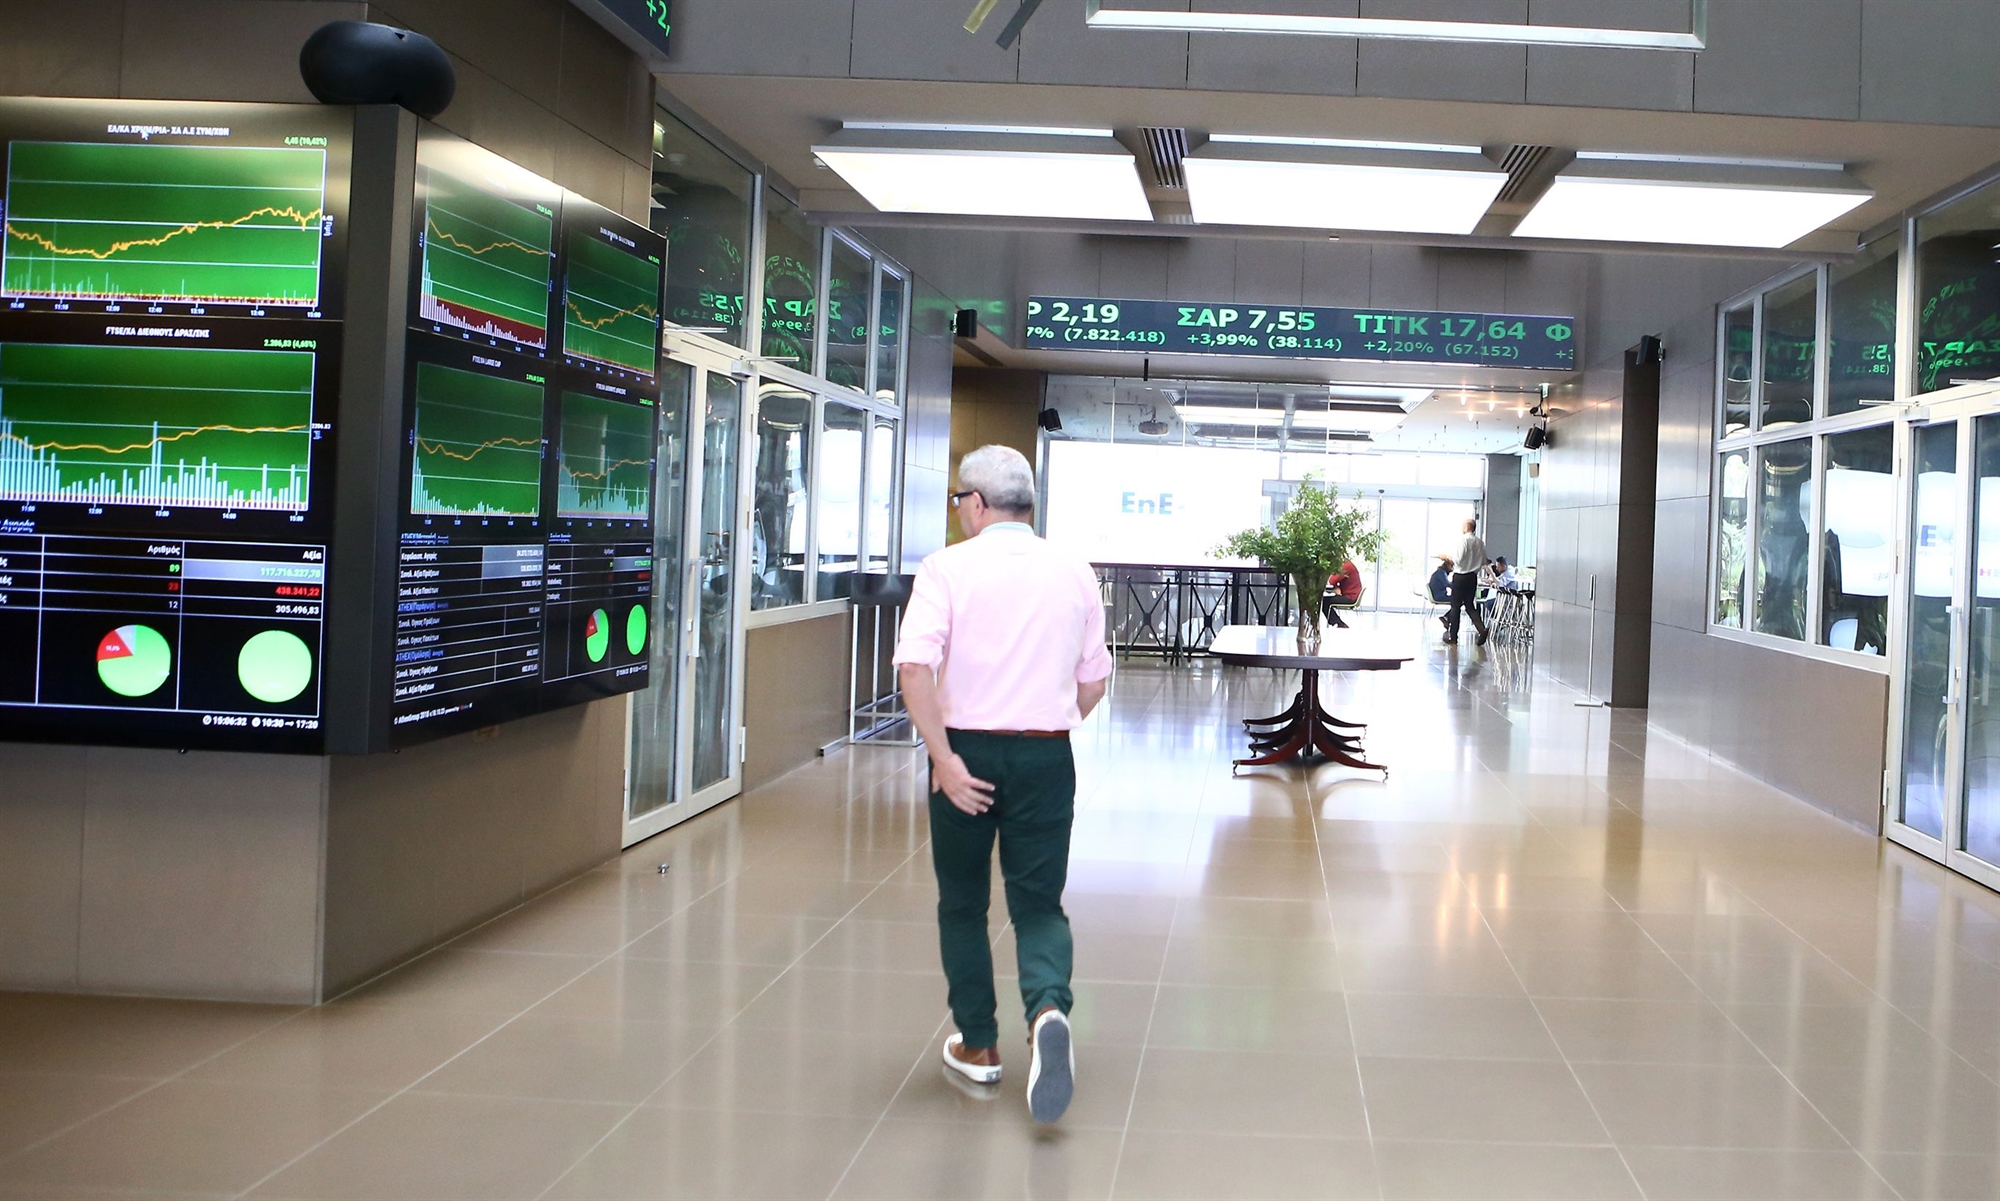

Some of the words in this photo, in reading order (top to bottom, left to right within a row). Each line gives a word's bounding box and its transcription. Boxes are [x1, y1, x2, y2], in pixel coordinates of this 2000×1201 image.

[1051, 302, 1119, 326] 2,19
[1177, 307, 1239, 328] ΣΑΡ
[1248, 309, 1316, 334] 7,55
[1027, 326, 1055, 339] 7%
[1064, 327, 1166, 345] (7.822.418)
[1353, 314, 1429, 336] ΤΙΤΚ
[1440, 318, 1526, 341] 17,64
[1545, 323, 1572, 342] Φ
[1187, 333, 1258, 347] +3,99%
[1268, 335, 1342, 351] (38.114)
[1364, 340, 1434, 354] +2,20%
[1445, 343, 1519, 360] (67.152)
[302, 550, 322, 561] Αξία
[168, 601, 179, 609] 12
[275, 605, 320, 616] 305.496,83
[295, 719, 319, 729] 17:20
